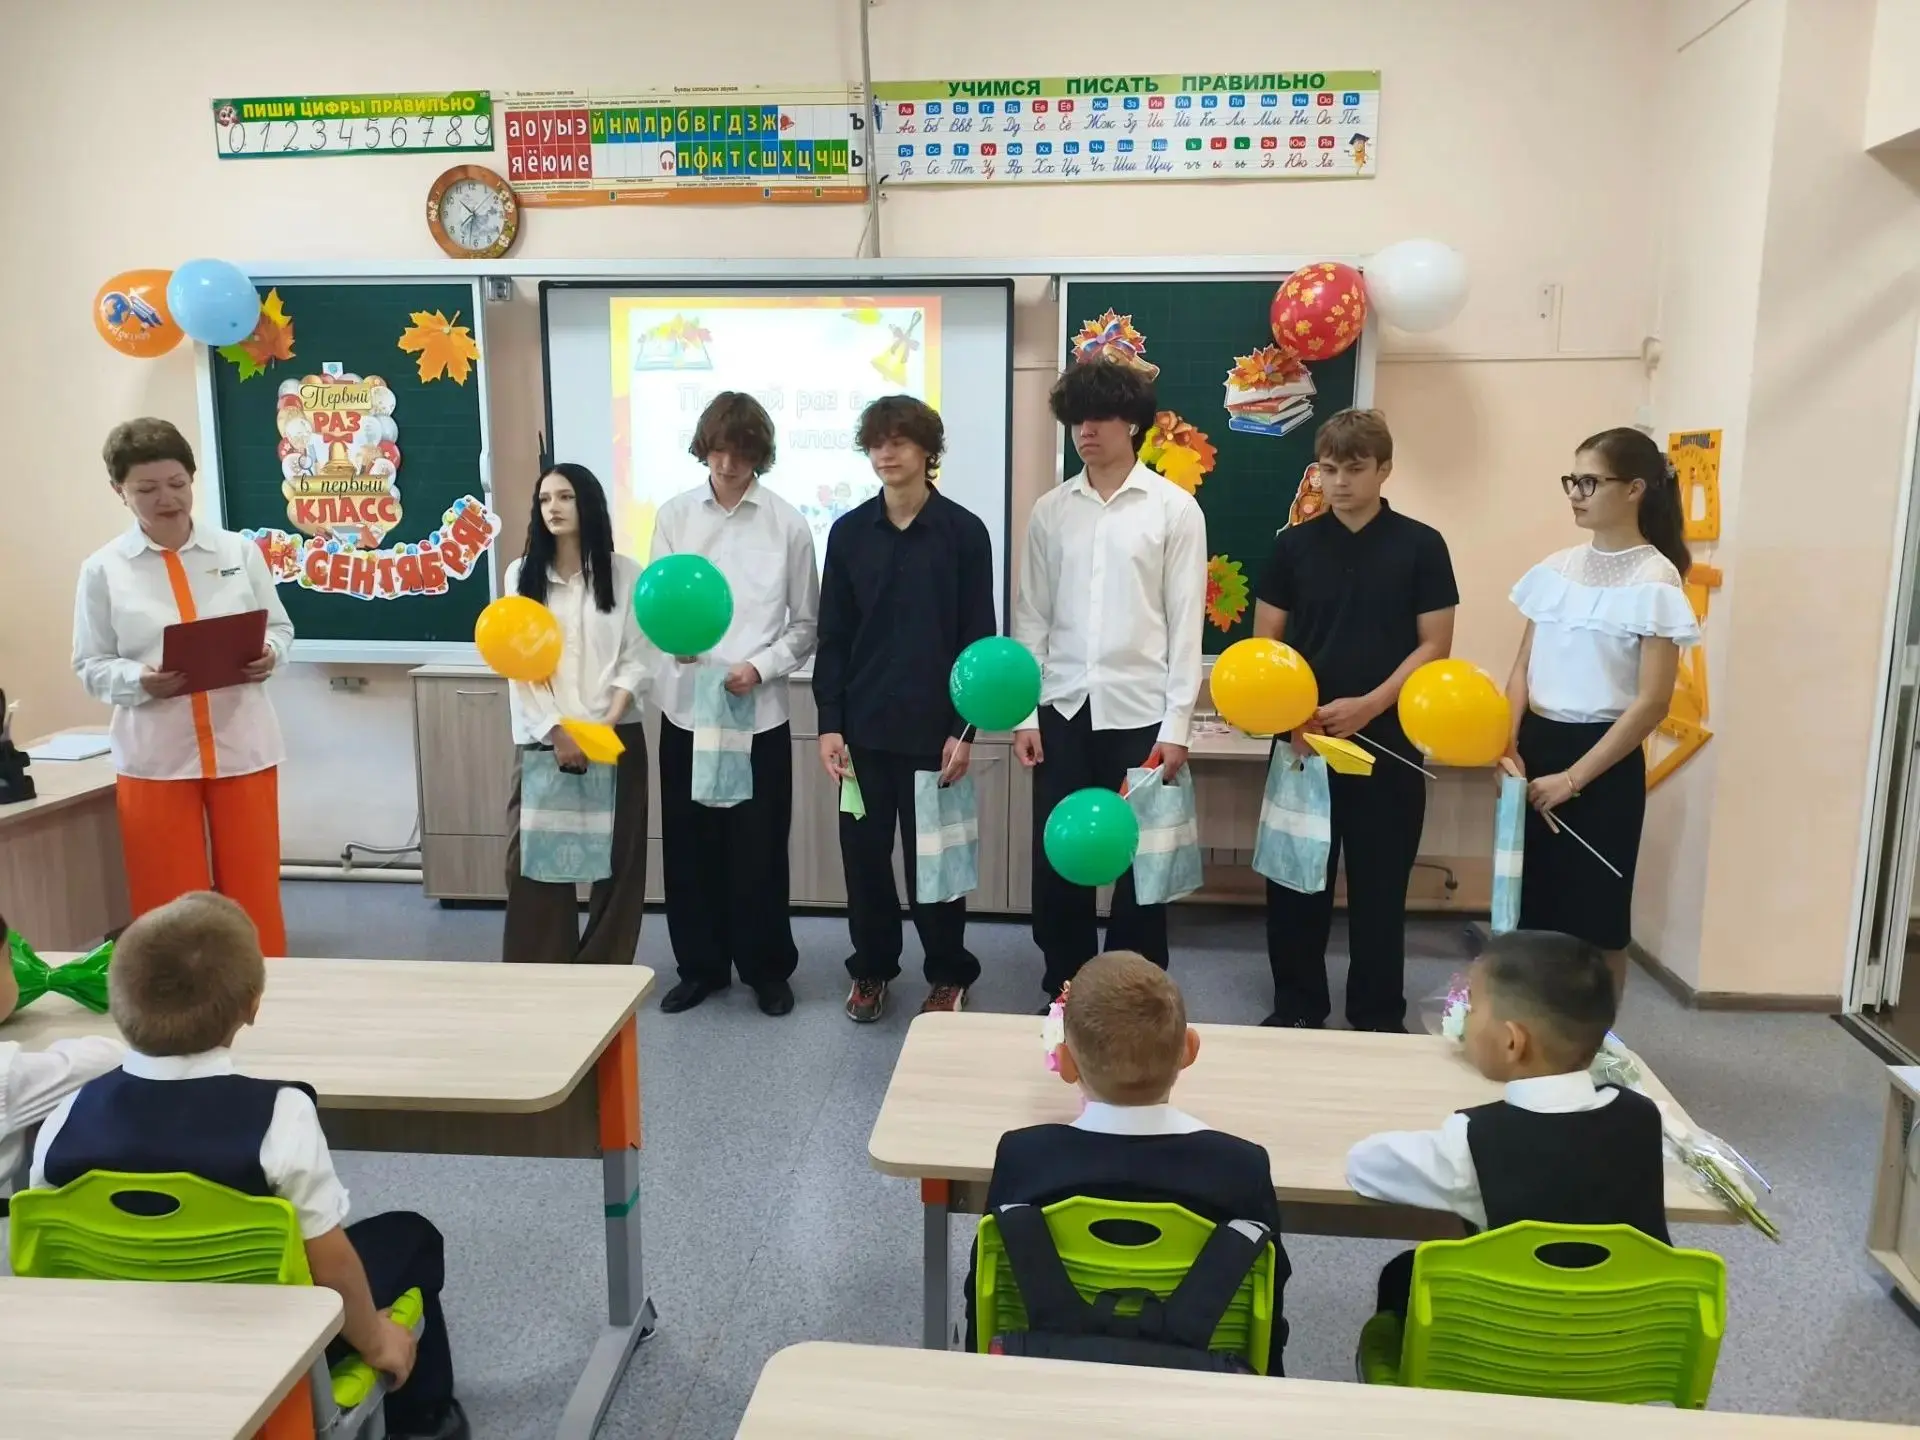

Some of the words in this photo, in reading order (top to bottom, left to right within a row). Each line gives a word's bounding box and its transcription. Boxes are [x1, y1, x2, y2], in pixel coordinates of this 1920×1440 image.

[948, 79, 1041, 97] УЧИМСЯ
[1066, 76, 1159, 94] ПИСАТЬ
[1182, 73, 1325, 92] ПРАВИЛЬНО
[243, 103, 296, 118] ПИШИ
[300, 100, 366, 117] ЦИФРЫ
[371, 97, 476, 114] ПРАВИЛЬНО
[299, 383, 369, 410] Первый
[796, 389, 838, 419] раз
[312, 411, 361, 433] РАЗ
[300, 474, 310, 493] в
[320, 475, 385, 500] первый
[295, 496, 398, 525] КЛАСС
